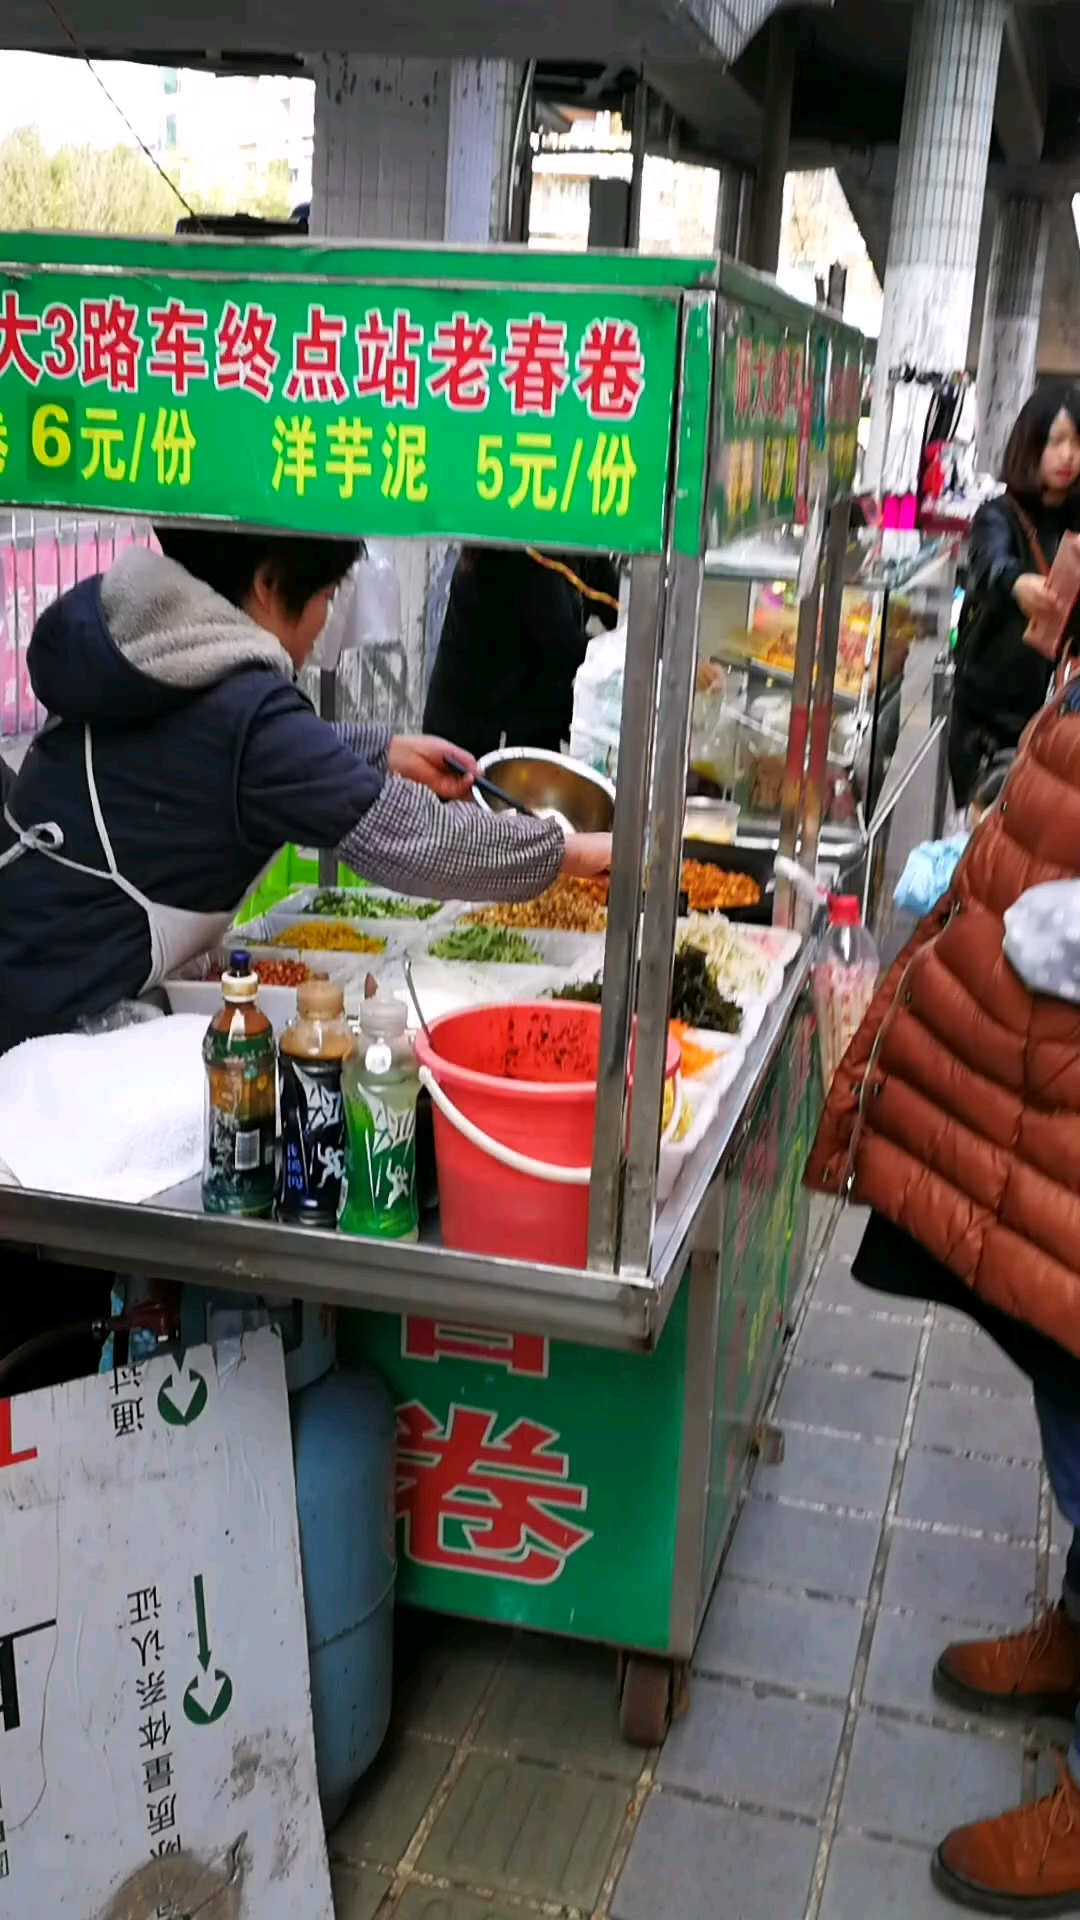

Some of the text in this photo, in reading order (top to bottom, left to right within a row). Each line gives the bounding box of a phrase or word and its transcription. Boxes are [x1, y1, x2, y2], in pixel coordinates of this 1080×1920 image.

[0, 290, 645, 420] 大3路车终点站老春卷
[32, 404, 196, 486] 6元/份
[272, 416, 428, 501] 洋芋泥
[476, 434, 636, 516] 5元/份
